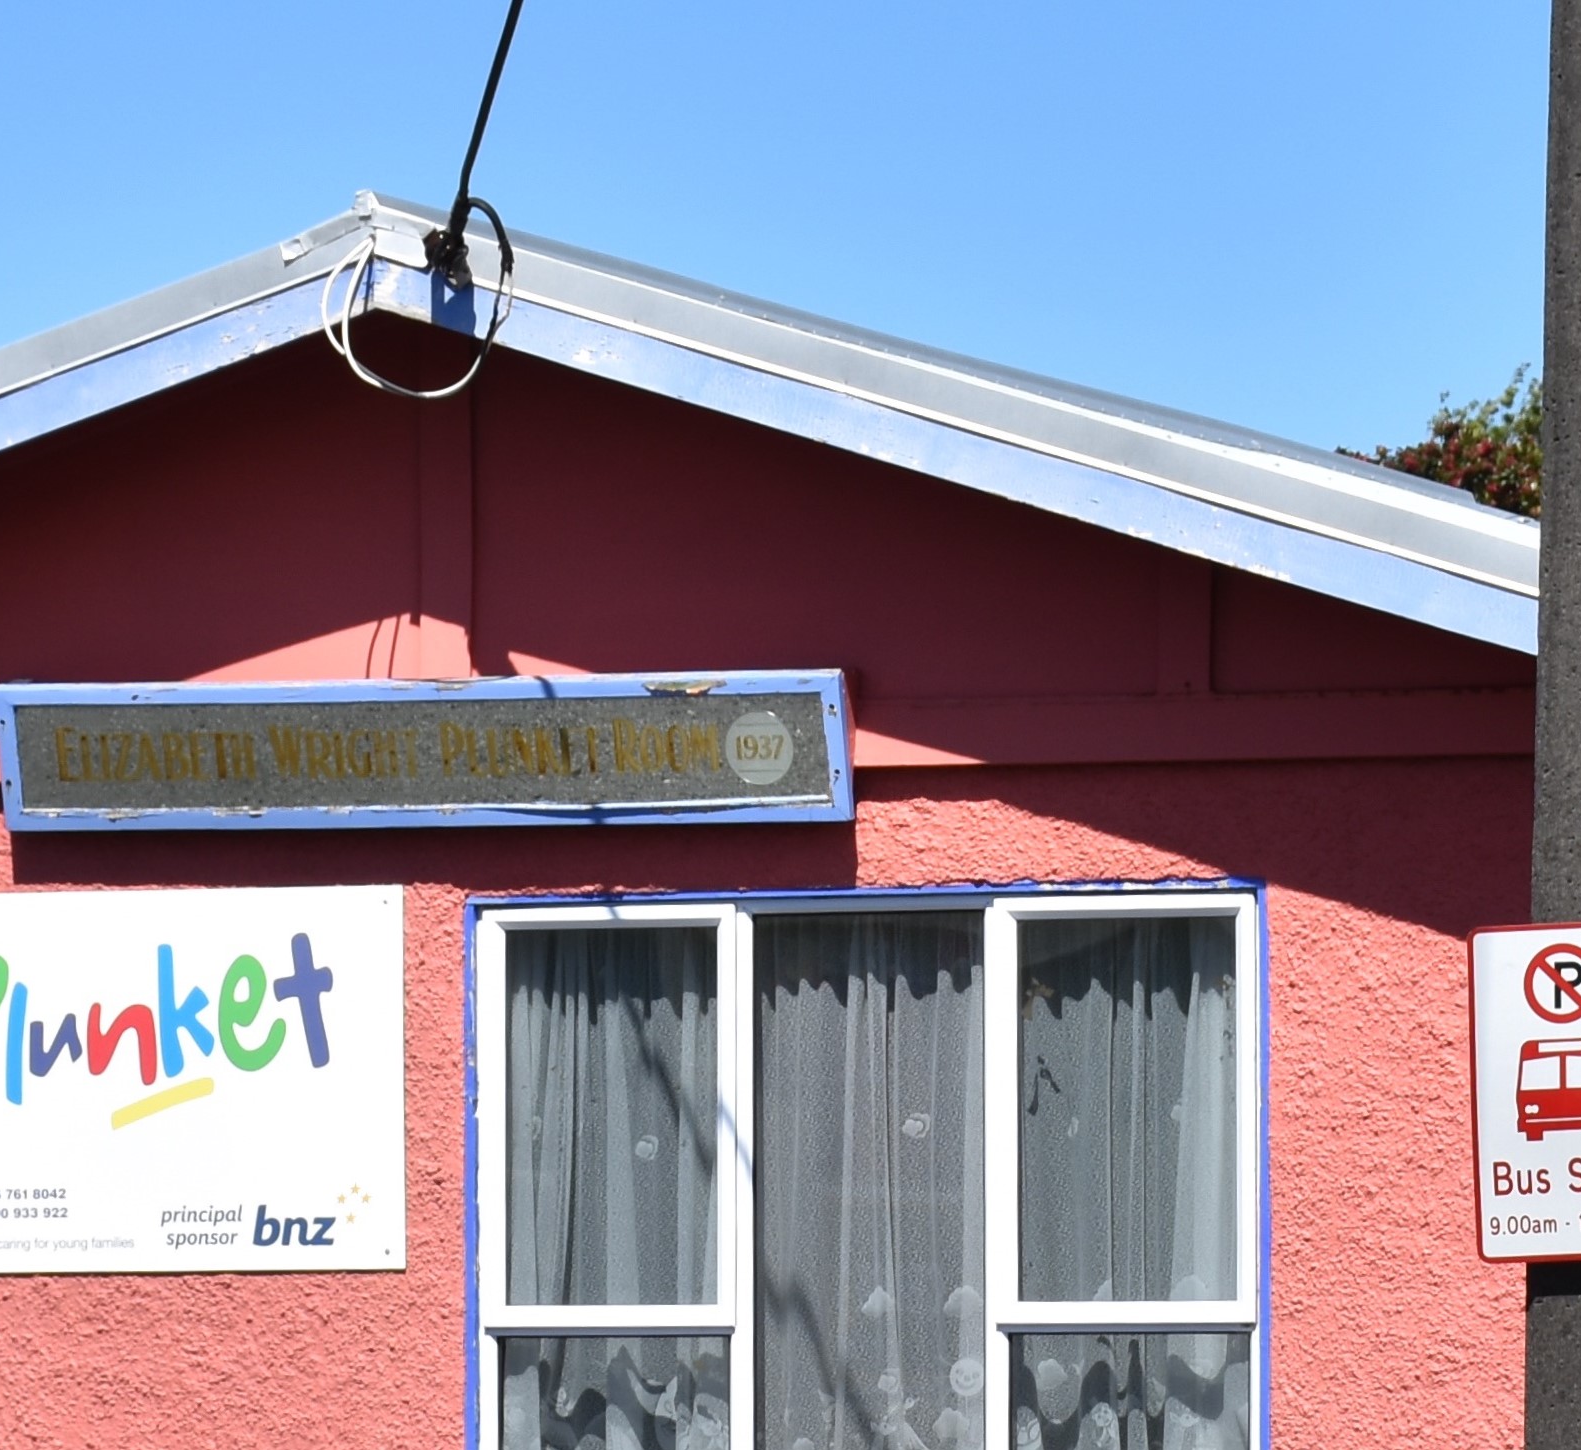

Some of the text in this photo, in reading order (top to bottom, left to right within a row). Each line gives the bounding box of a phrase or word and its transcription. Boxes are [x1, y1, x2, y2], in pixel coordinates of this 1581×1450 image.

[55, 726, 258, 783] ELIZABETH
[267, 724, 422, 780] WRIGHT
[611, 717, 722, 775] ROOM
[735, 734, 785, 761] 1937
[1492, 1160, 1551, 1197] Bus
[6, 1188, 28, 1200] 761
[32, 1188, 67, 1200] 8042
[13, 1207, 39, 1219] 933
[43, 1207, 69, 1218] 922
[161, 1204, 243, 1228] principal
[252, 1204, 337, 1247] bnz
[1489, 1215, 1558, 1236] 9.00am
[34, 1237, 49, 1250] for
[53, 1239, 88, 1251] young
[91, 1236, 135, 1249] families
[166, 1231, 239, 1250] sponsor
